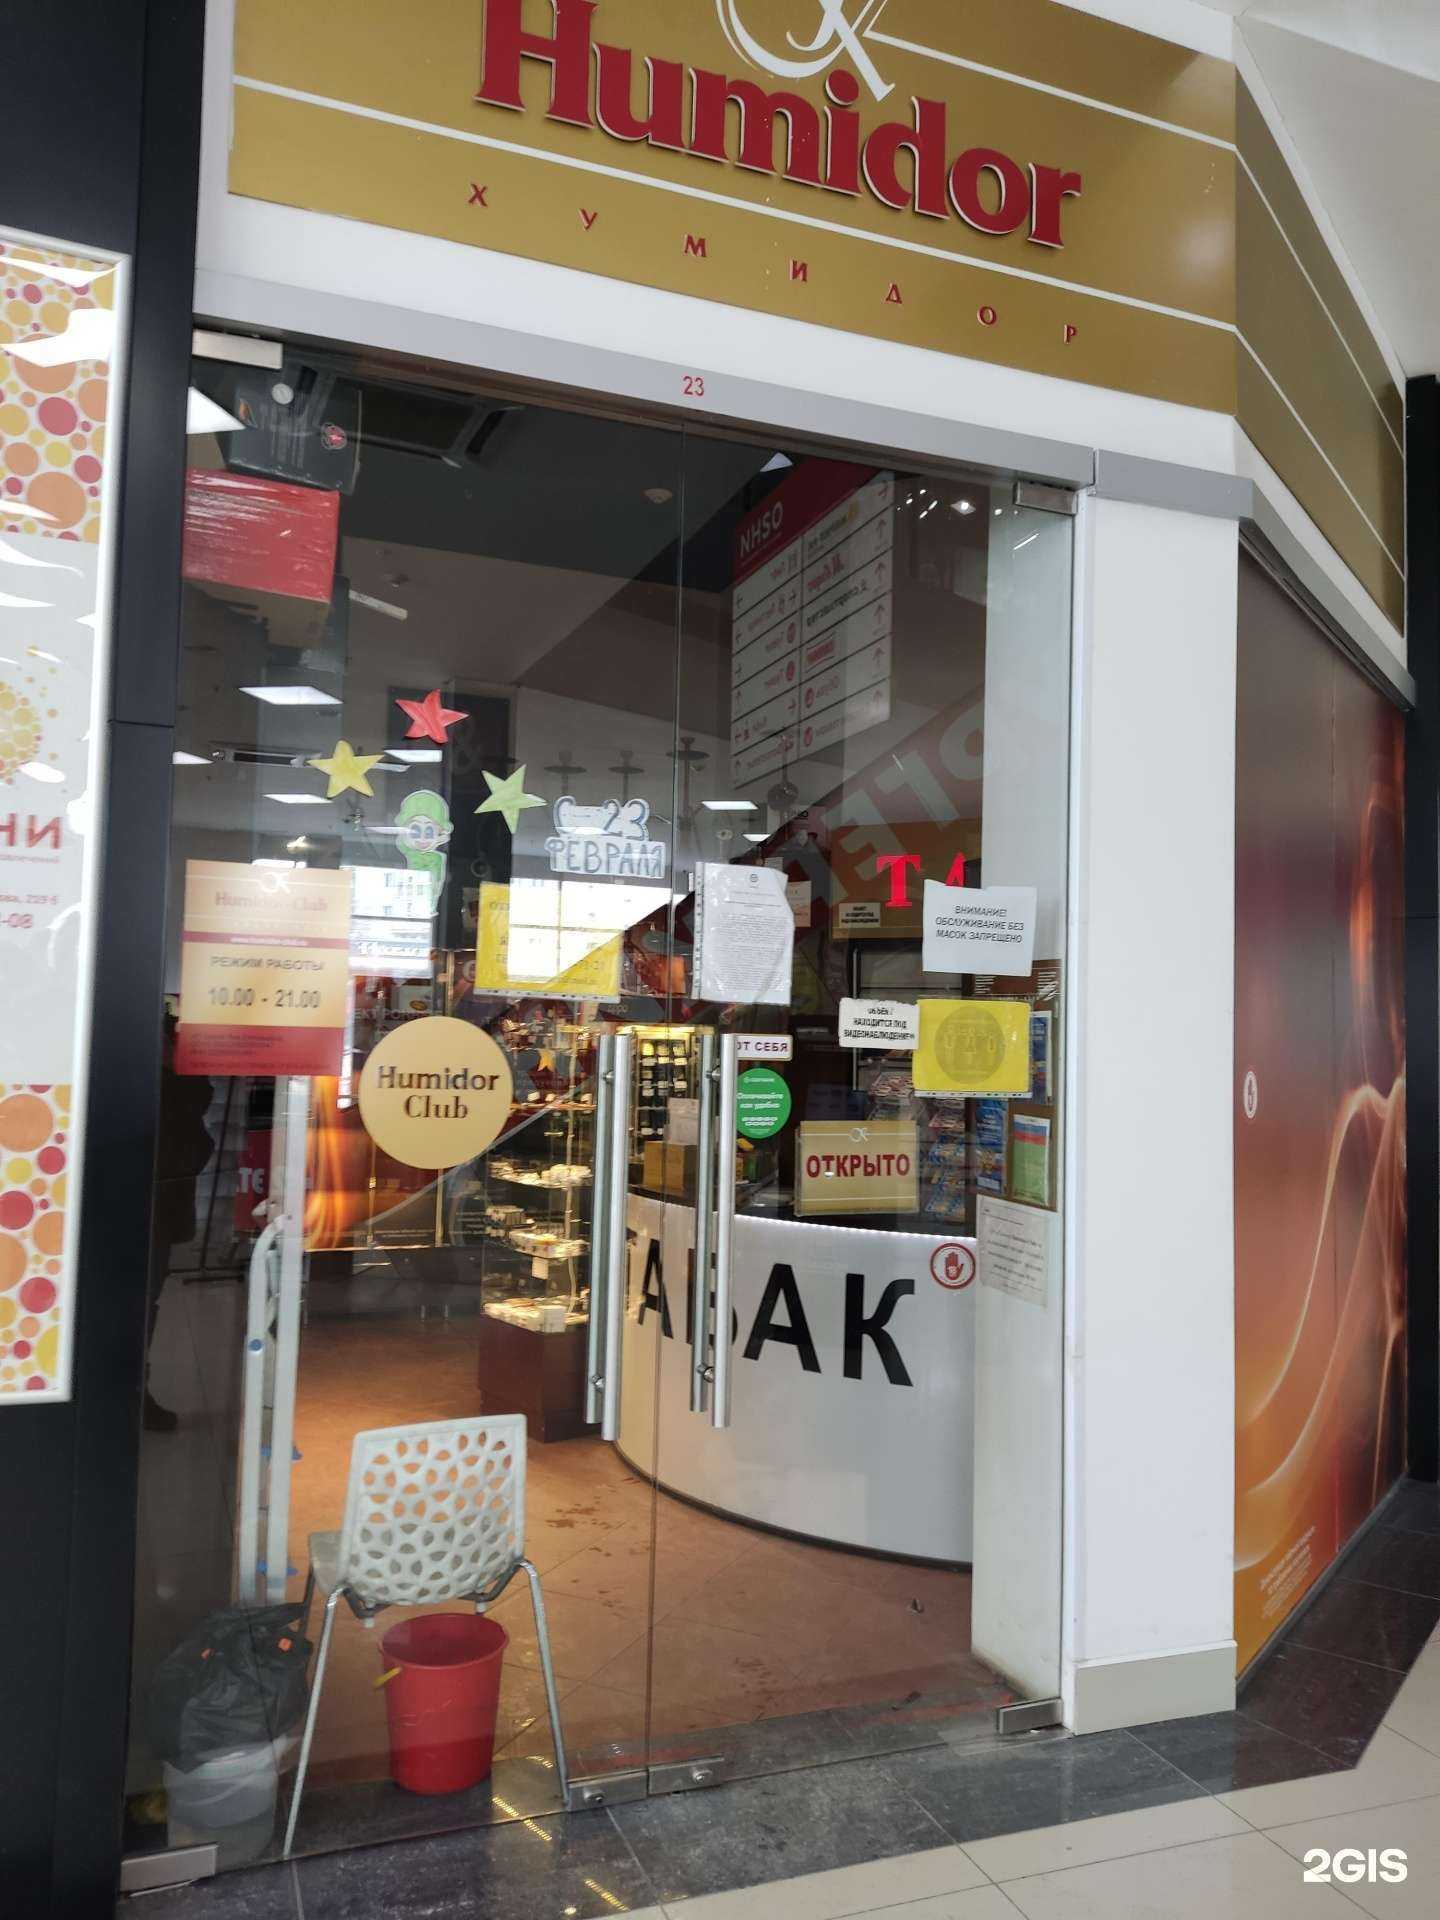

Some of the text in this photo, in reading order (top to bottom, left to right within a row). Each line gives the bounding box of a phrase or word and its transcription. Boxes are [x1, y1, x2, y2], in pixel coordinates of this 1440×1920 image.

[473, 0, 1082, 249] Humidor
[682, 375, 705, 397] 23
[601, 797, 649, 841] 23
[935, 916, 1024, 931] ОБСЛУЖИВАНИЕ БЕЗ
[936, 929, 1022, 943] МАСОК ЗАПРЕЩЕНО
[210, 955, 324, 972] РЕЖИМ РАБОТЫ
[754, 1042, 788, 1052] СЕБЯ
[377, 1065, 500, 1091] Humidor
[403, 1094, 469, 1119] Club
[806, 1153, 911, 1179] ОТКРЫТО
